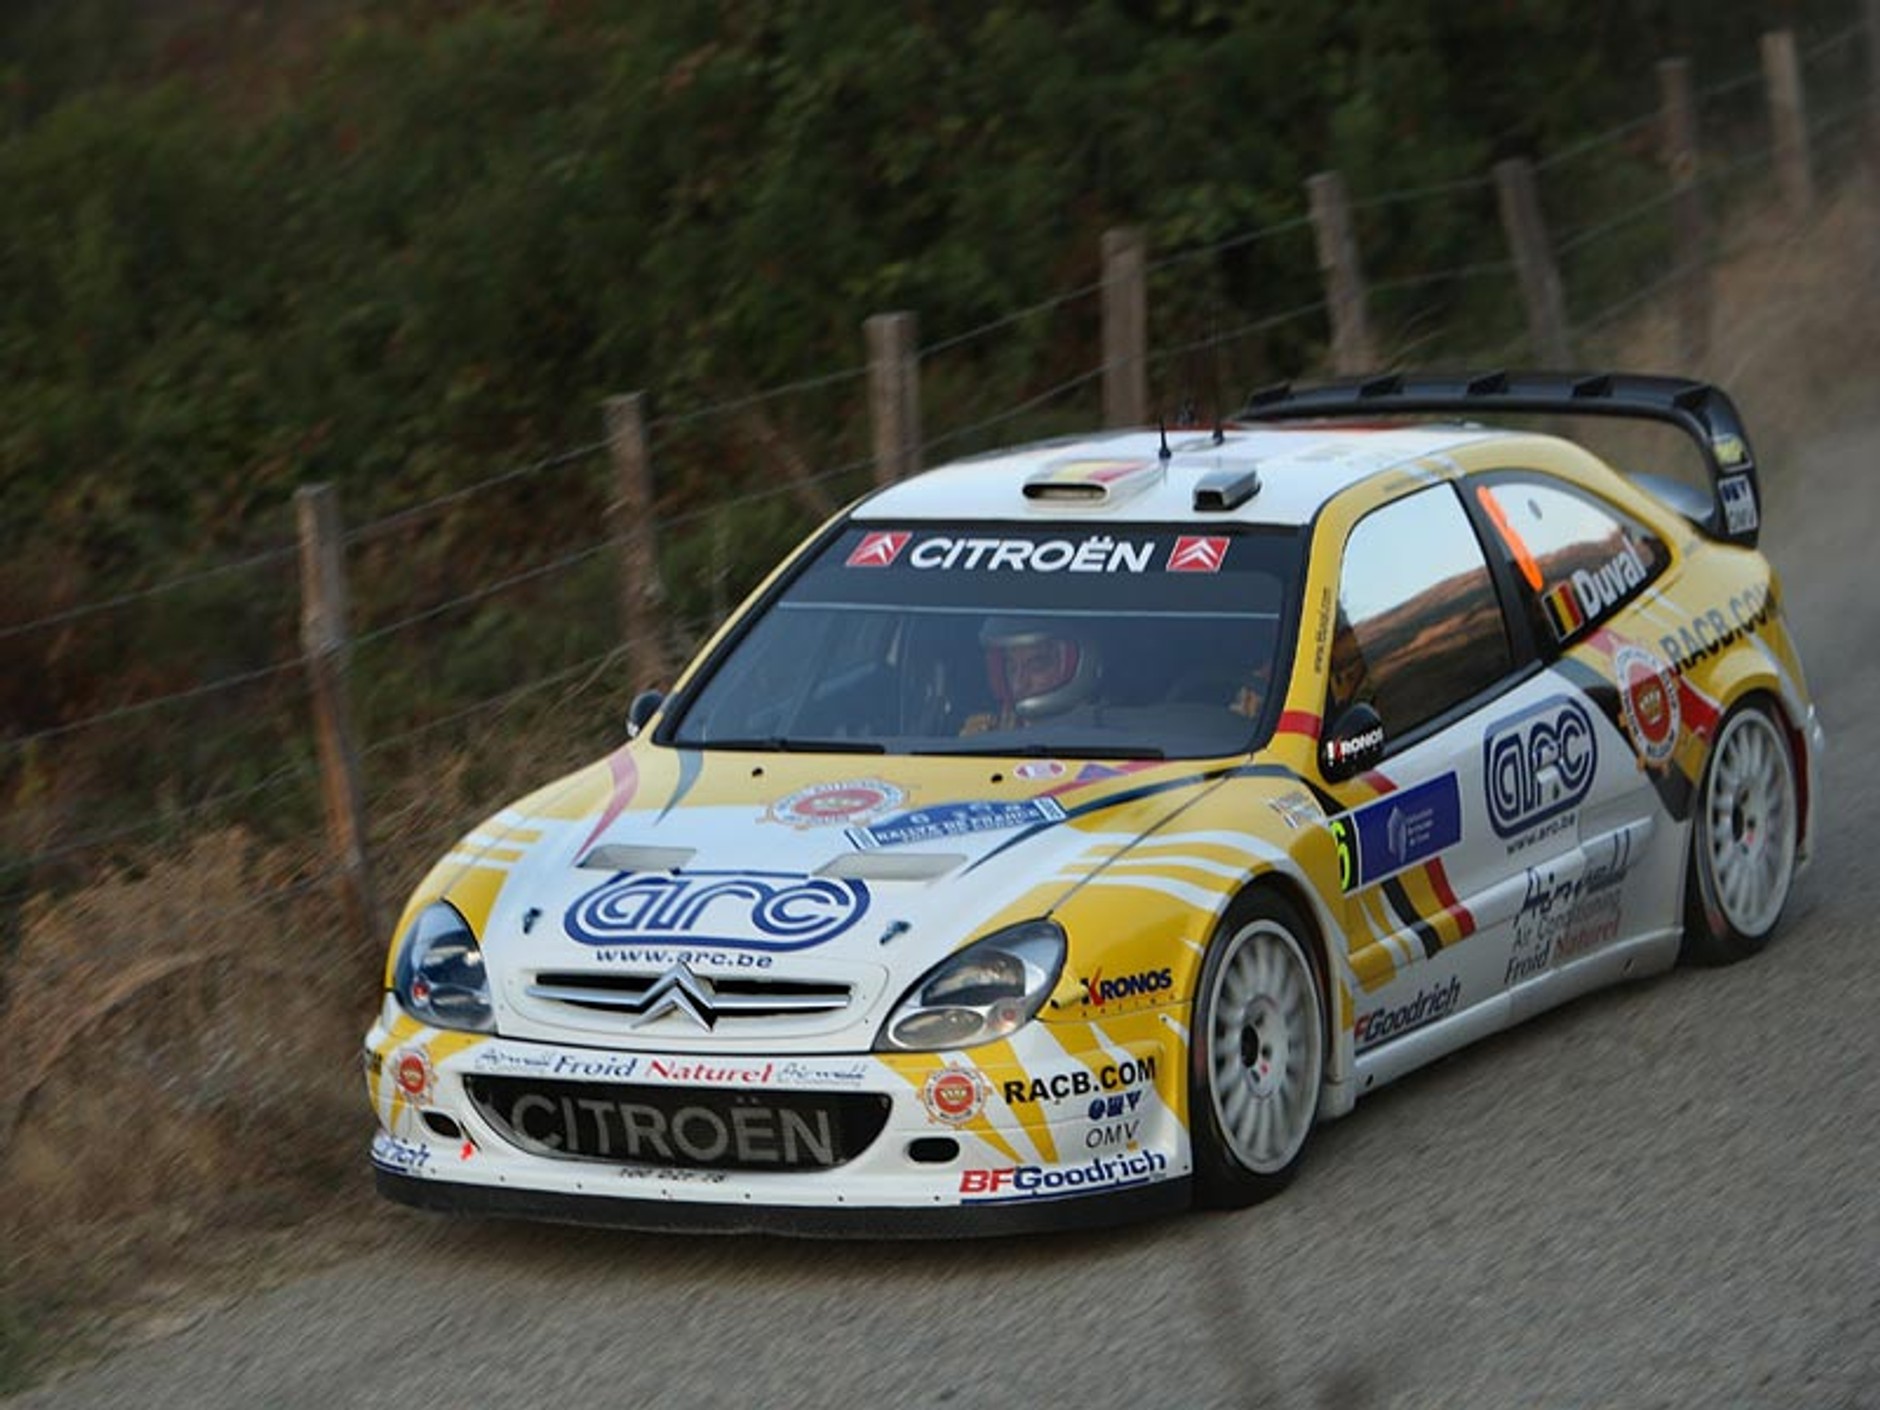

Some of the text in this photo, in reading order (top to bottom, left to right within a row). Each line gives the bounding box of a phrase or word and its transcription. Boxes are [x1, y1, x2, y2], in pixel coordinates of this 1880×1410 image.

[910, 536, 1155, 572] CITROËN
[1572, 534, 1647, 619] Duval
[1491, 709, 1591, 823] arc
[584, 875, 852, 937] arc
[596, 948, 774, 969] www.arc.be
[1504, 940, 1550, 985] Froid
[1081, 966, 1173, 1006] KRONOS
[1353, 975, 1461, 1042] FGoodrich
[553, 1055, 639, 1078] Froid
[646, 1060, 774, 1084] Naturel
[1003, 1056, 1156, 1105] RACB.COM
[511, 1093, 834, 1165] CITROËN
[1086, 1119, 1140, 1148] OMV
[959, 1149, 1167, 1193] BFGoodrich
